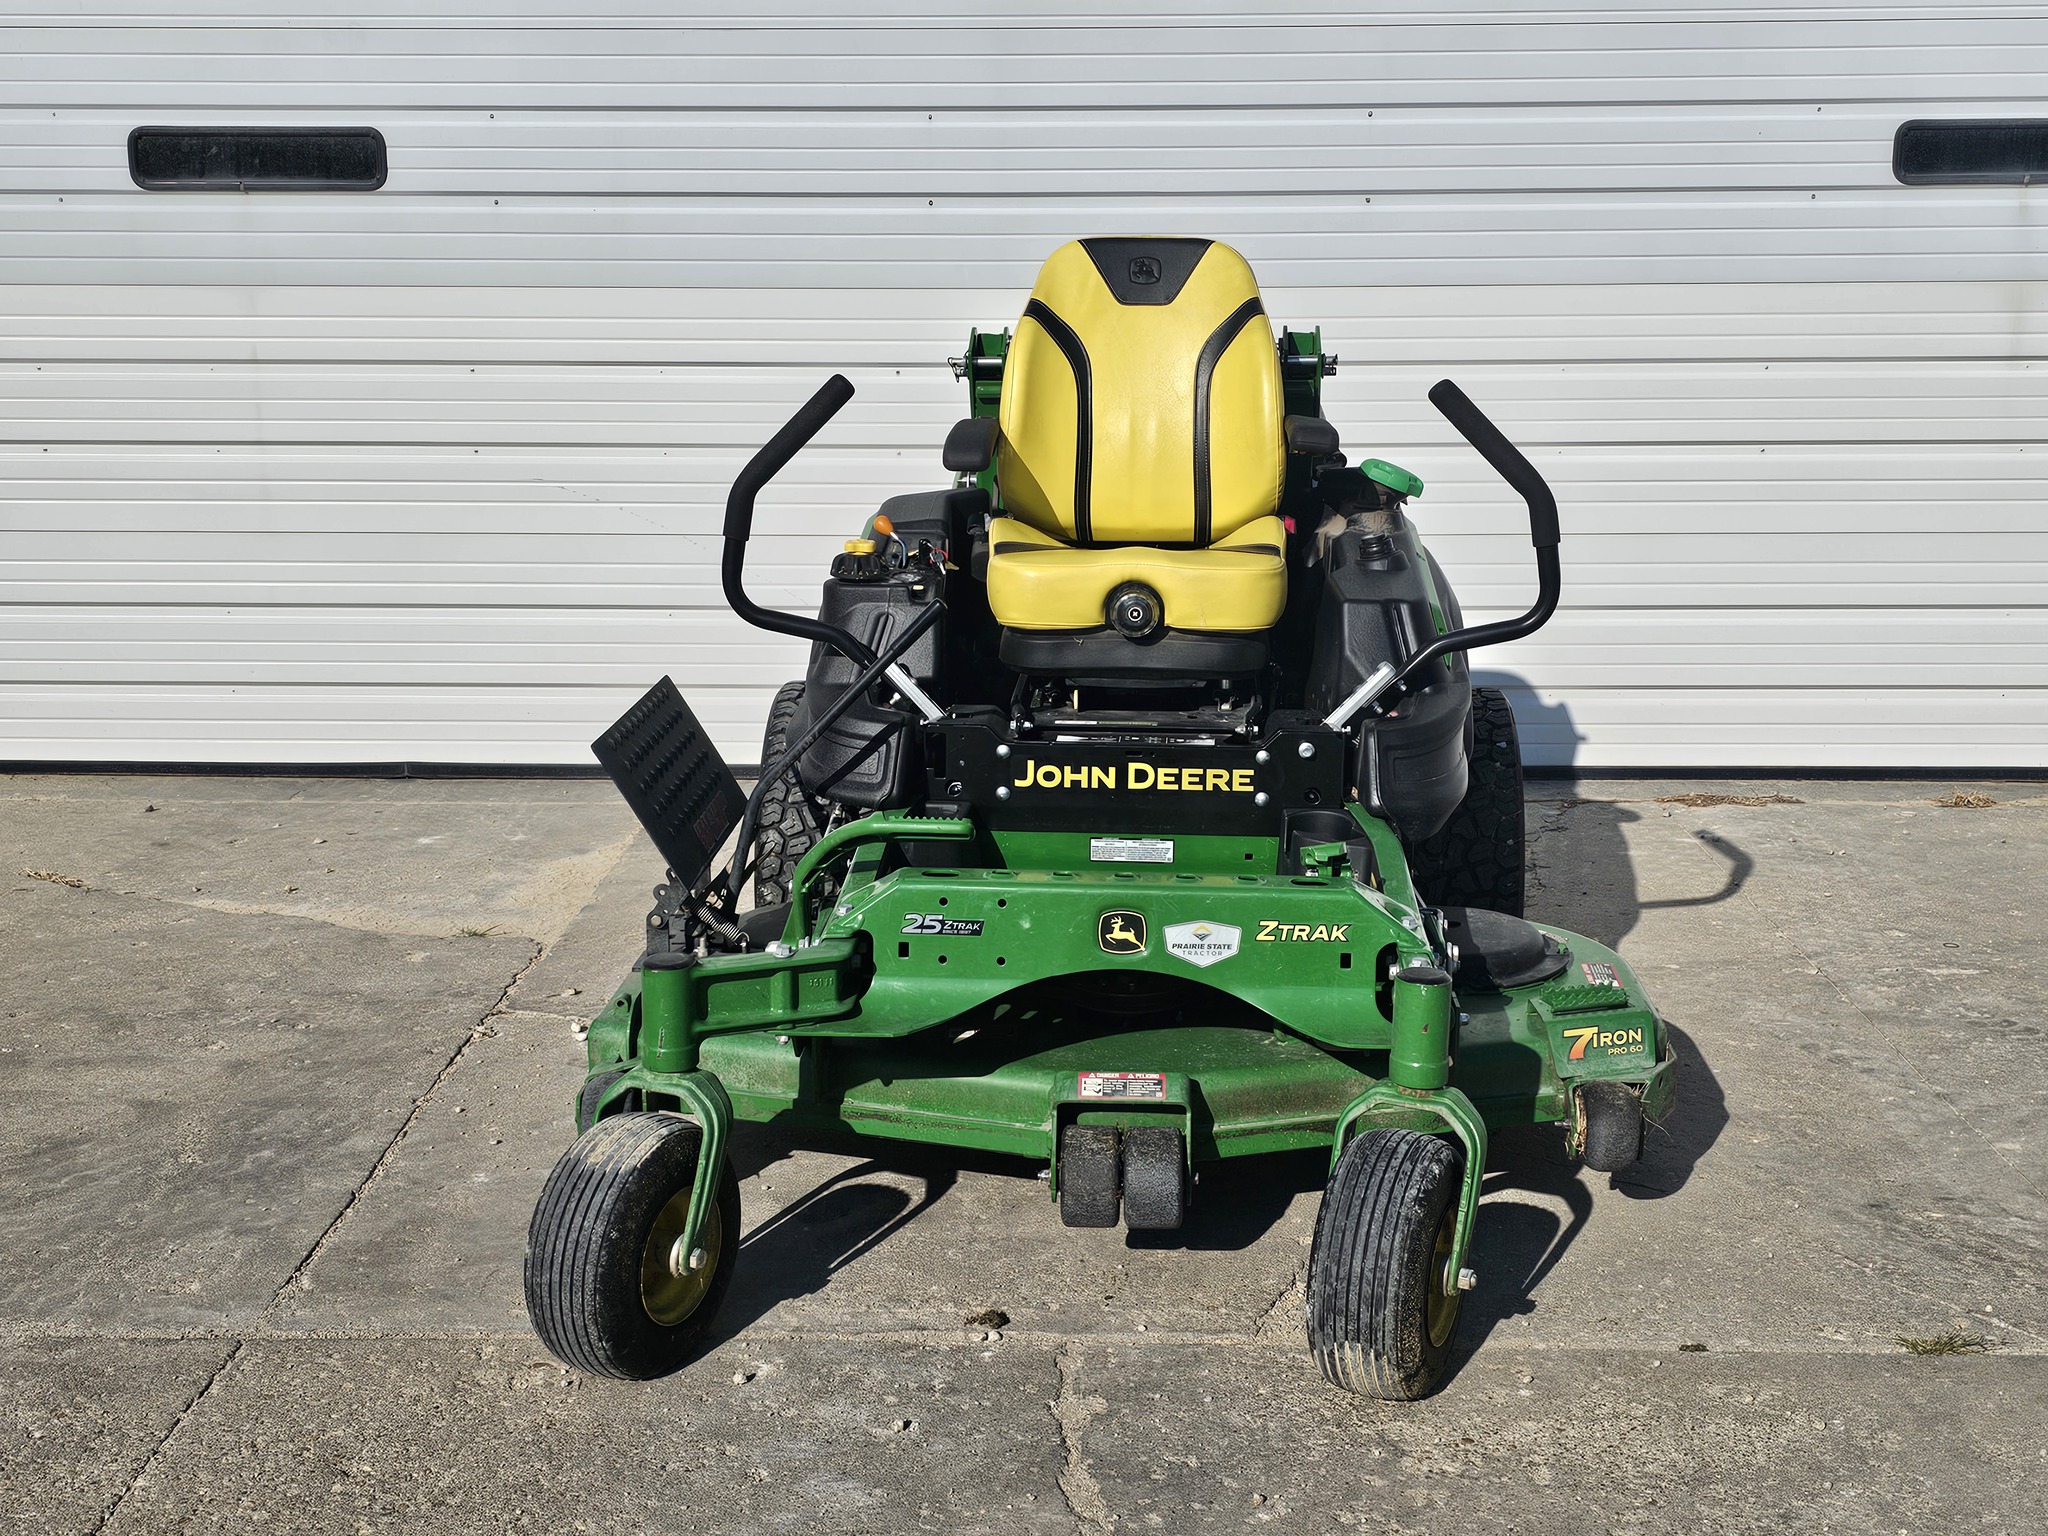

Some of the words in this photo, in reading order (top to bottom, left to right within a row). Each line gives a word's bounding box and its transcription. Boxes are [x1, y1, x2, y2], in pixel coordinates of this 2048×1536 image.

[1014, 759, 1116, 789] JOHN
[1127, 762, 1255, 791] DEERE
[901, 913, 944, 934] 25
[943, 920, 981, 931] ZTRAK
[1255, 920, 1350, 942] ZTRAK
[1607, 1046, 1628, 1056] PRO
[1630, 1044, 1643, 1053] 60
